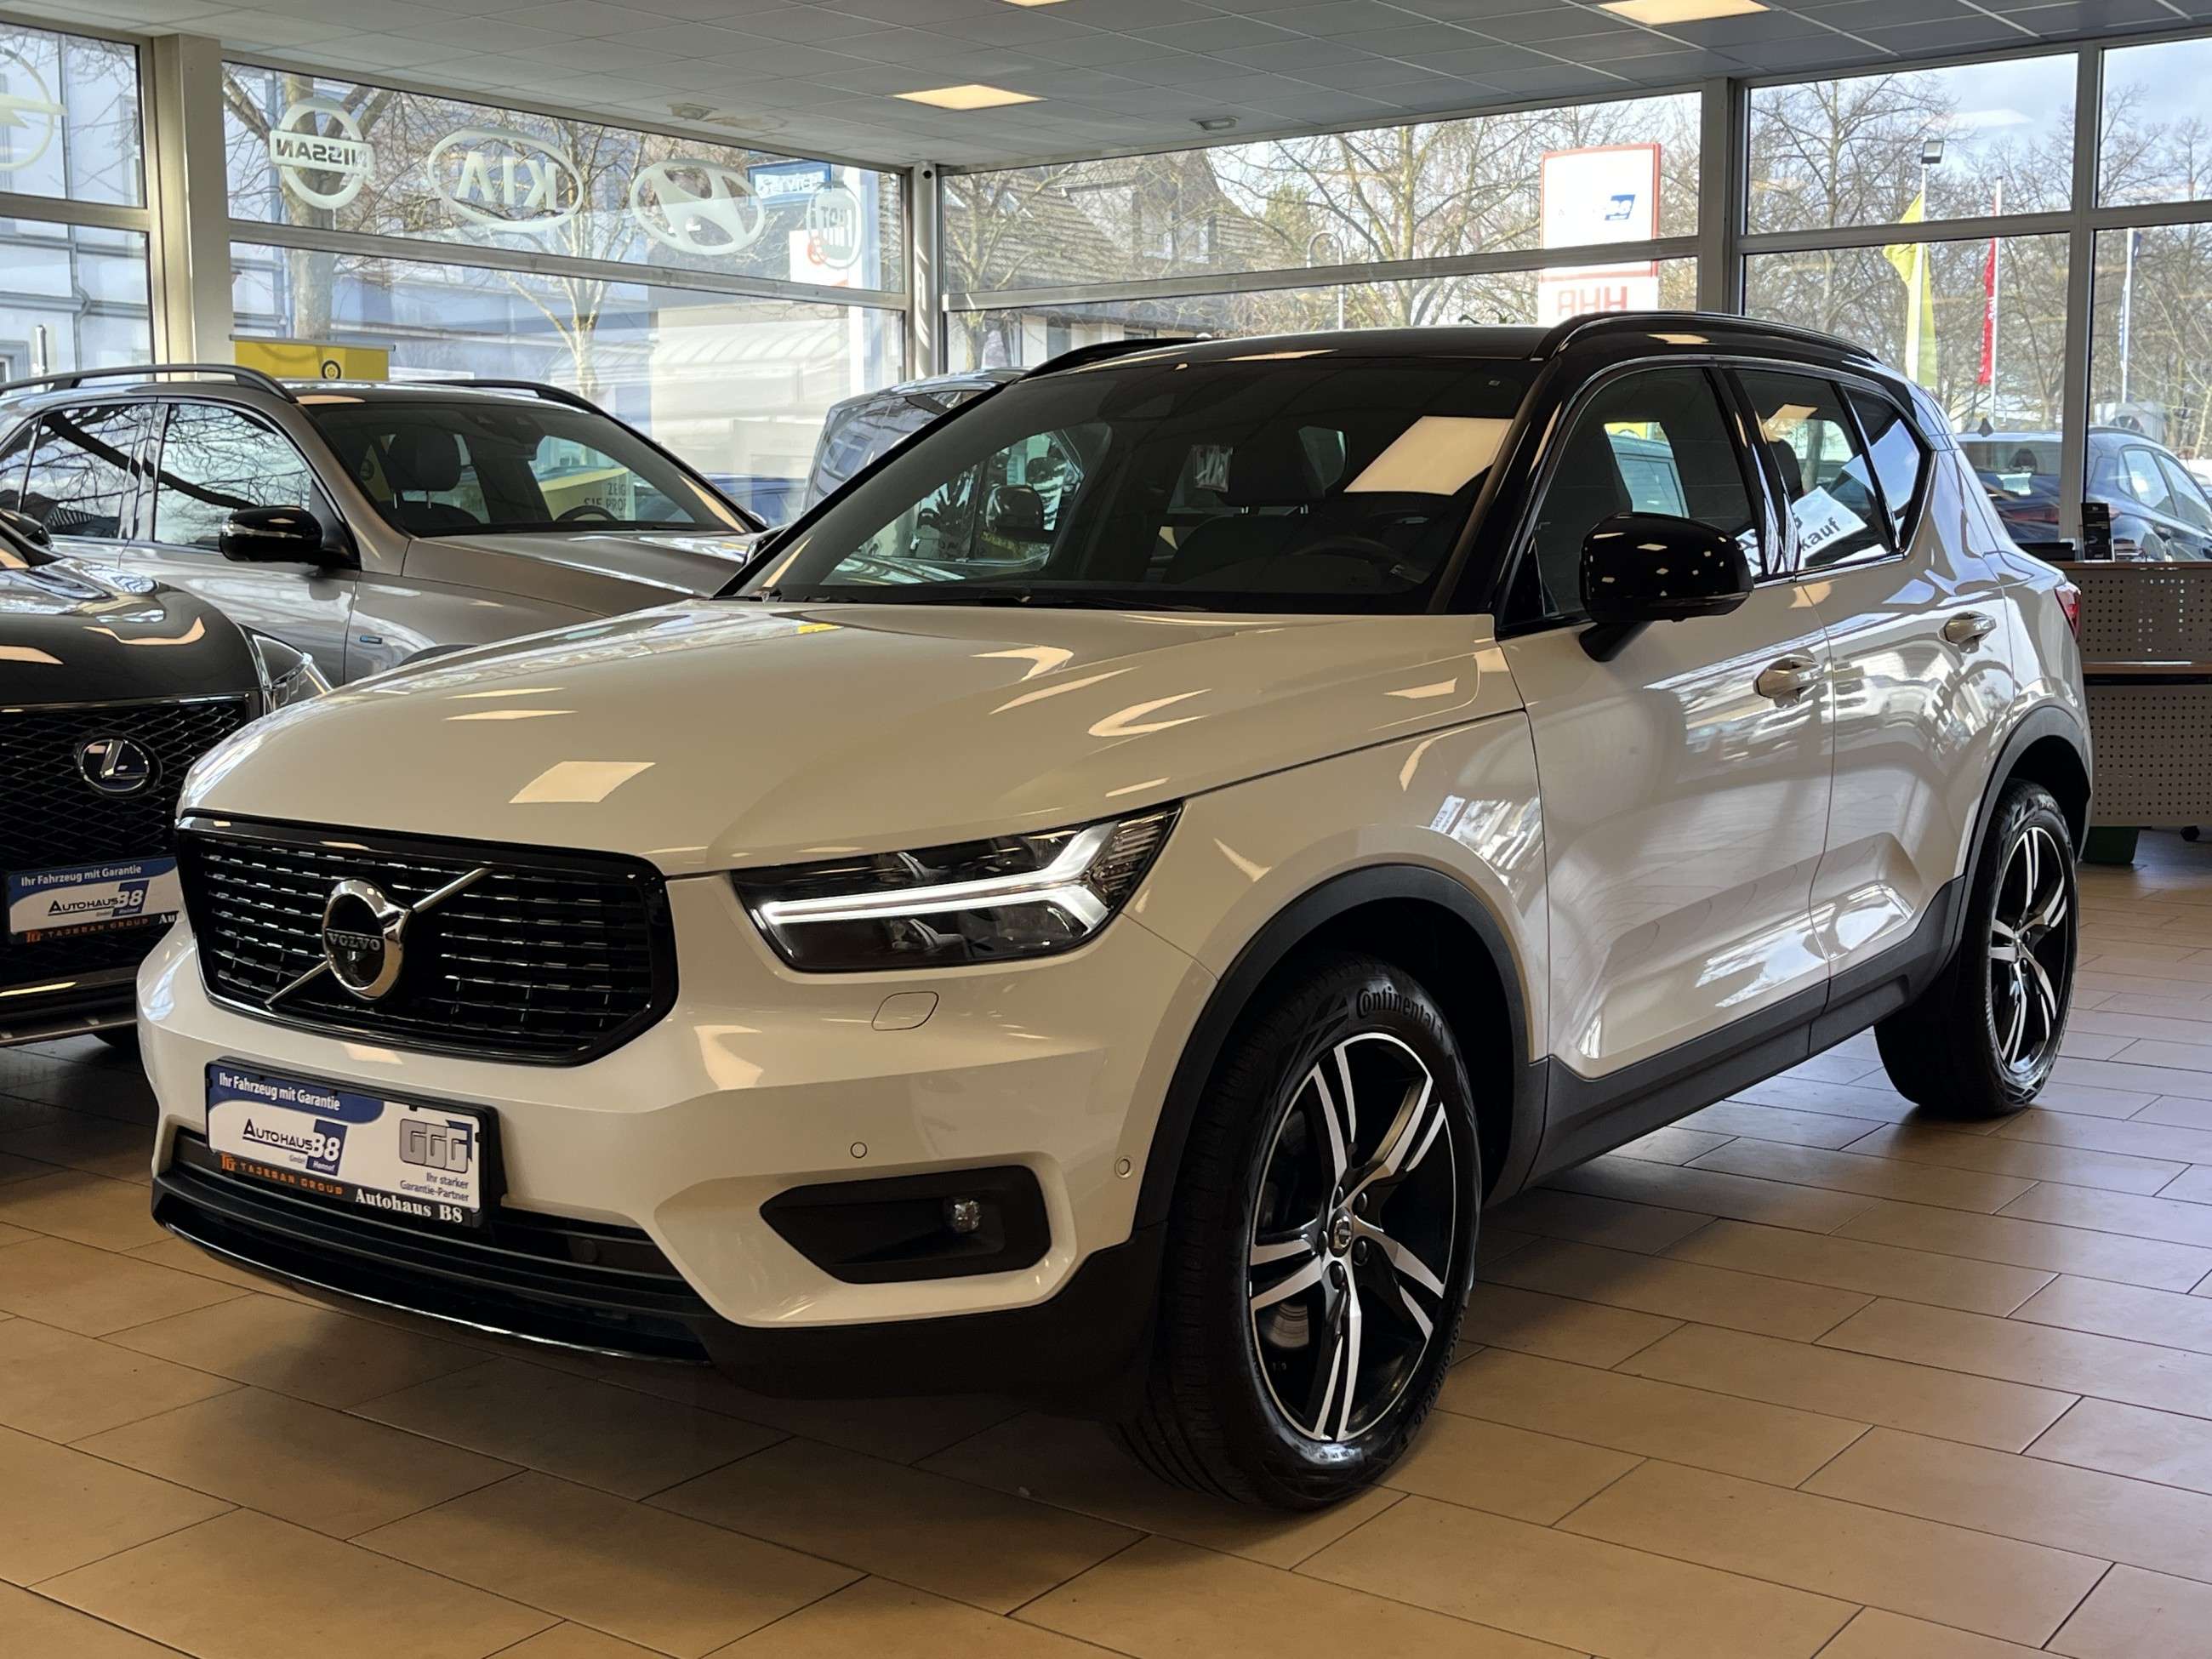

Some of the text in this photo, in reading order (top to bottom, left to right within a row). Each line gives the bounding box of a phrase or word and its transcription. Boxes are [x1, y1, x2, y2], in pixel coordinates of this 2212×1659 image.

[21, 864, 142, 887] Ihr Fahrzeug mit Garantie
[327, 932, 381, 951] VOLVO
[1356, 985, 1436, 1032] Continental
[219, 1072, 340, 1111] Ihr Fahrzeug mit Garantie
[400, 1179, 470, 1201] Garantie-Partner
[426, 1172, 469, 1189] Ihr starker
[356, 1189, 432, 1217] Autohaus
